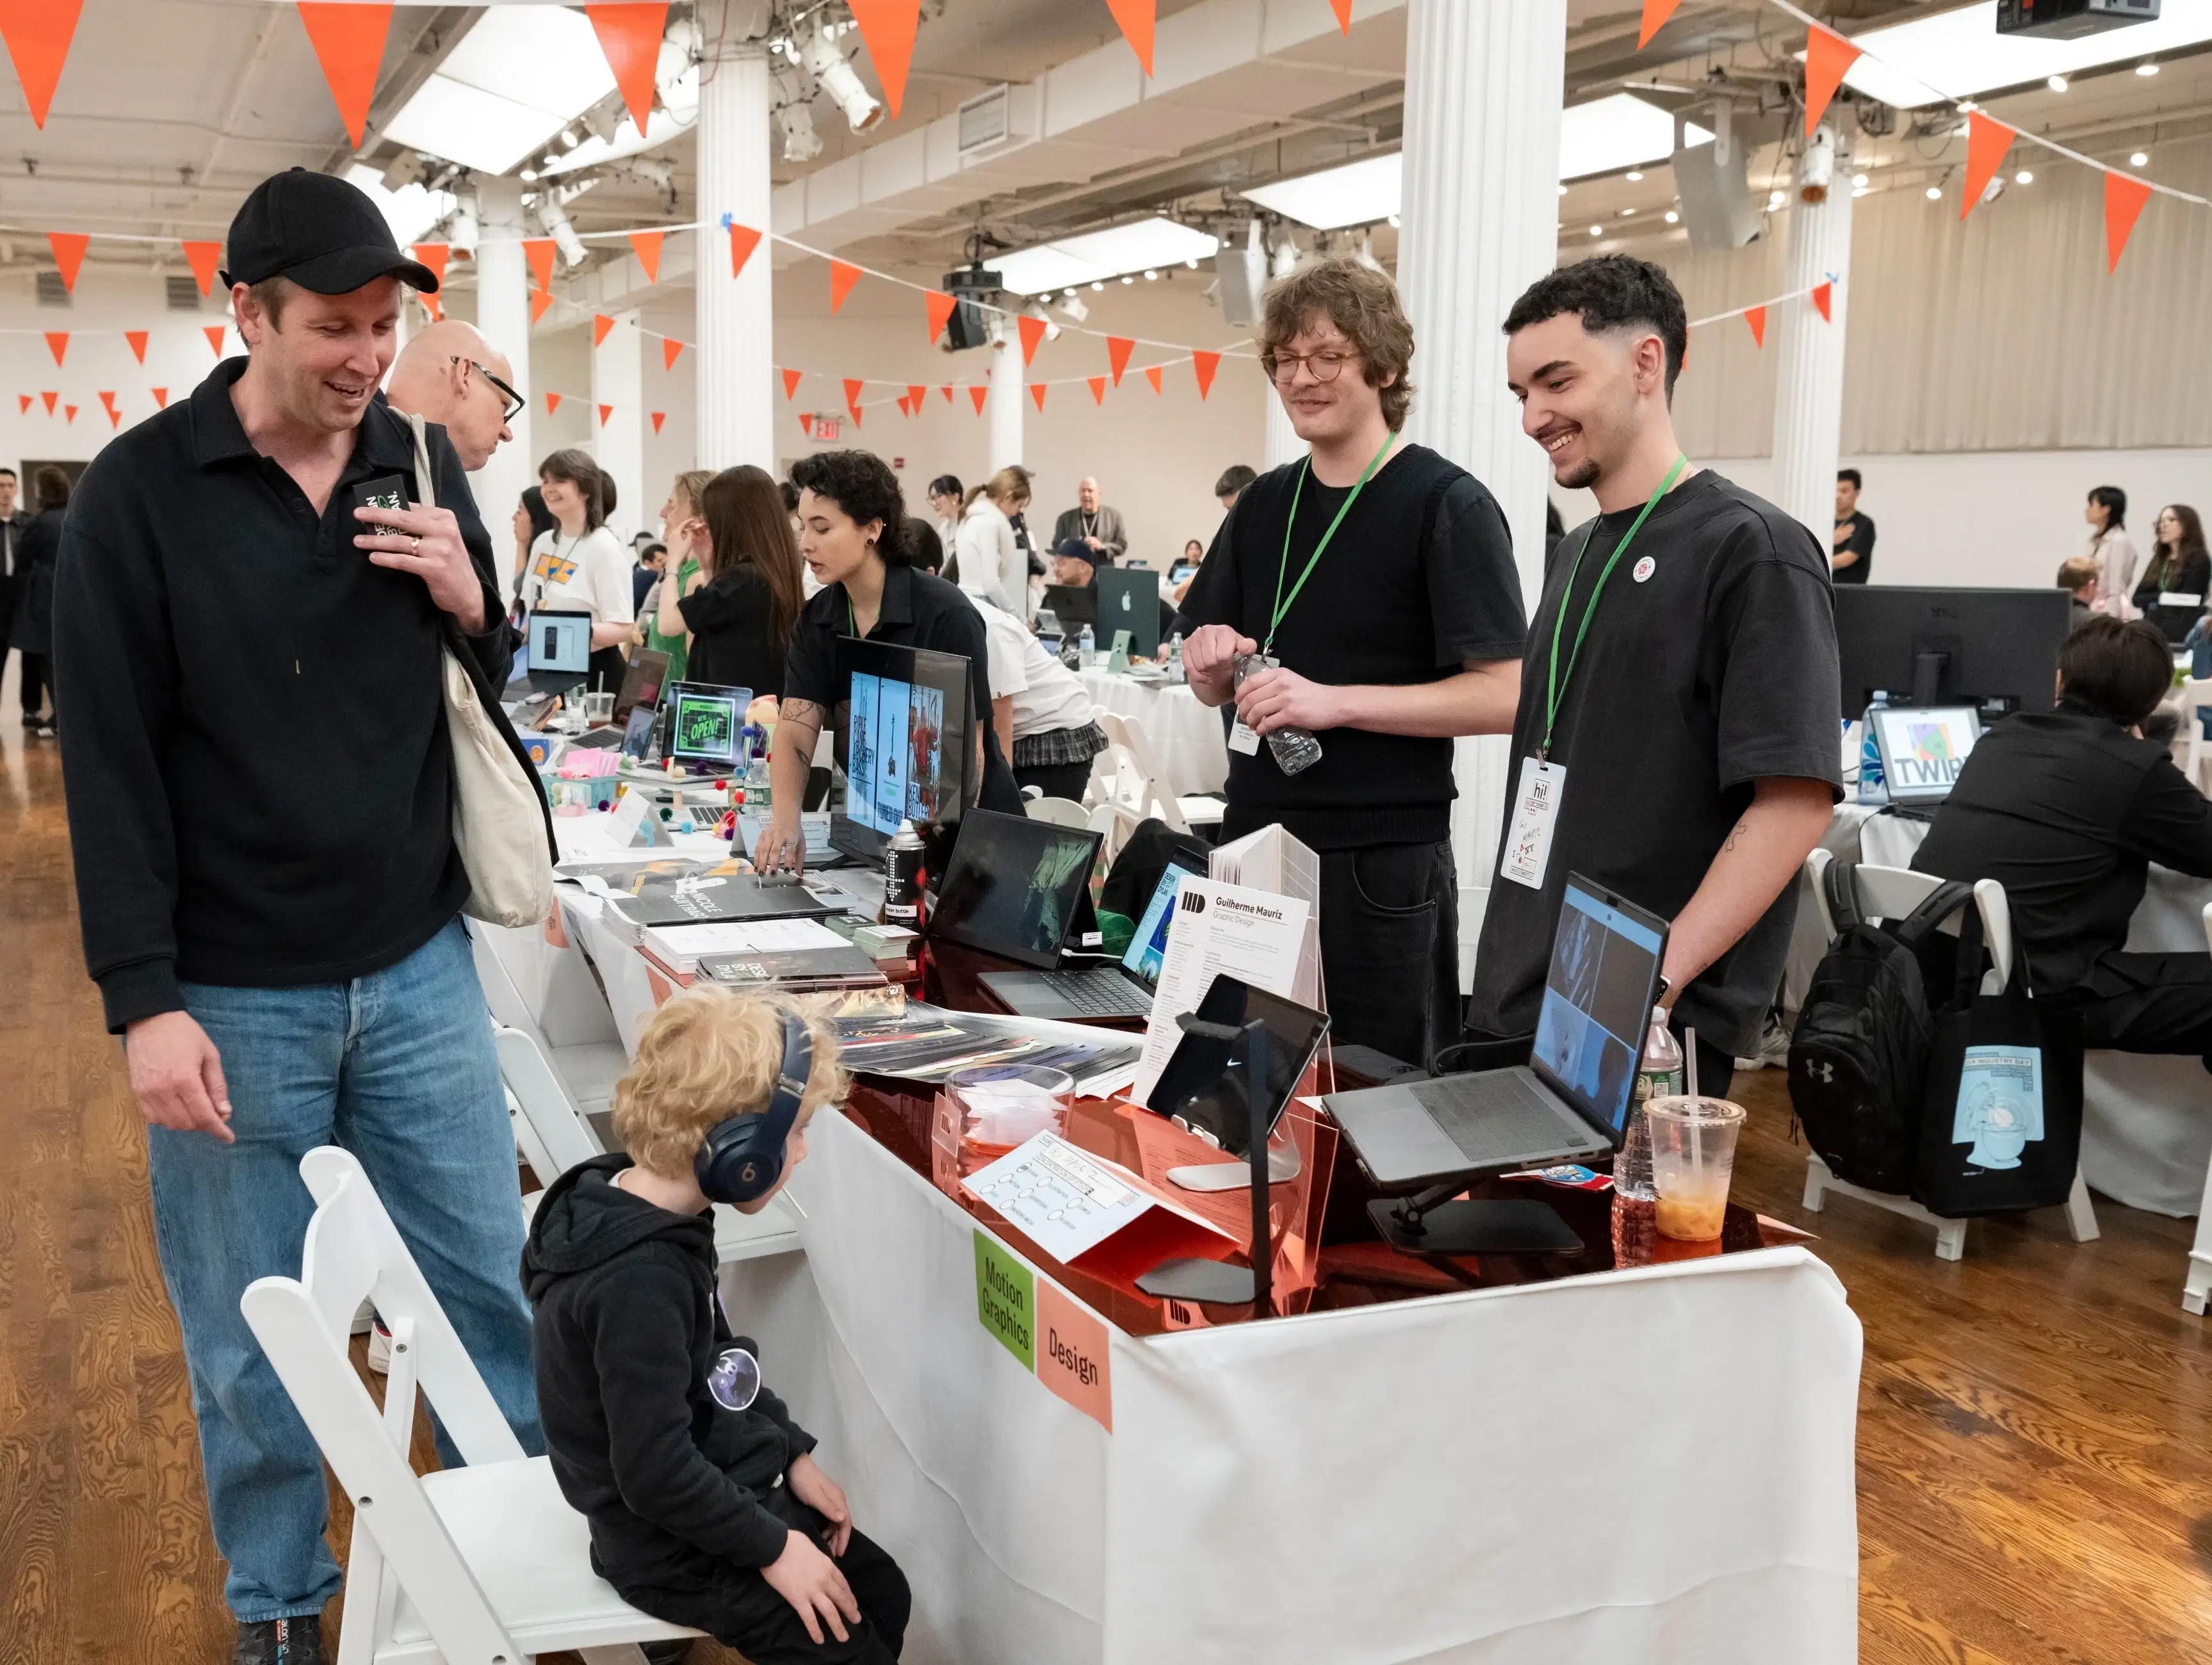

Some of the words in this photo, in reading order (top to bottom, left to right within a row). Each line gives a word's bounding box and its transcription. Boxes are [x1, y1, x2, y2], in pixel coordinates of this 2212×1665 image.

[691, 719, 719, 740] OPEN!
[909, 782, 920, 805] KEN
[1534, 782, 1547, 800] hi!
[692, 893, 723, 913] NICOLE
[1216, 897, 1255, 914] Guilherme
[1256, 906, 1283, 920] Mauriz
[1213, 910, 1235, 923] Graphic
[1235, 916, 1255, 928] Design
[986, 1256, 1023, 1311] Motion
[983, 1287, 1029, 1351] Graphics
[1050, 1326, 1098, 1386] Design
